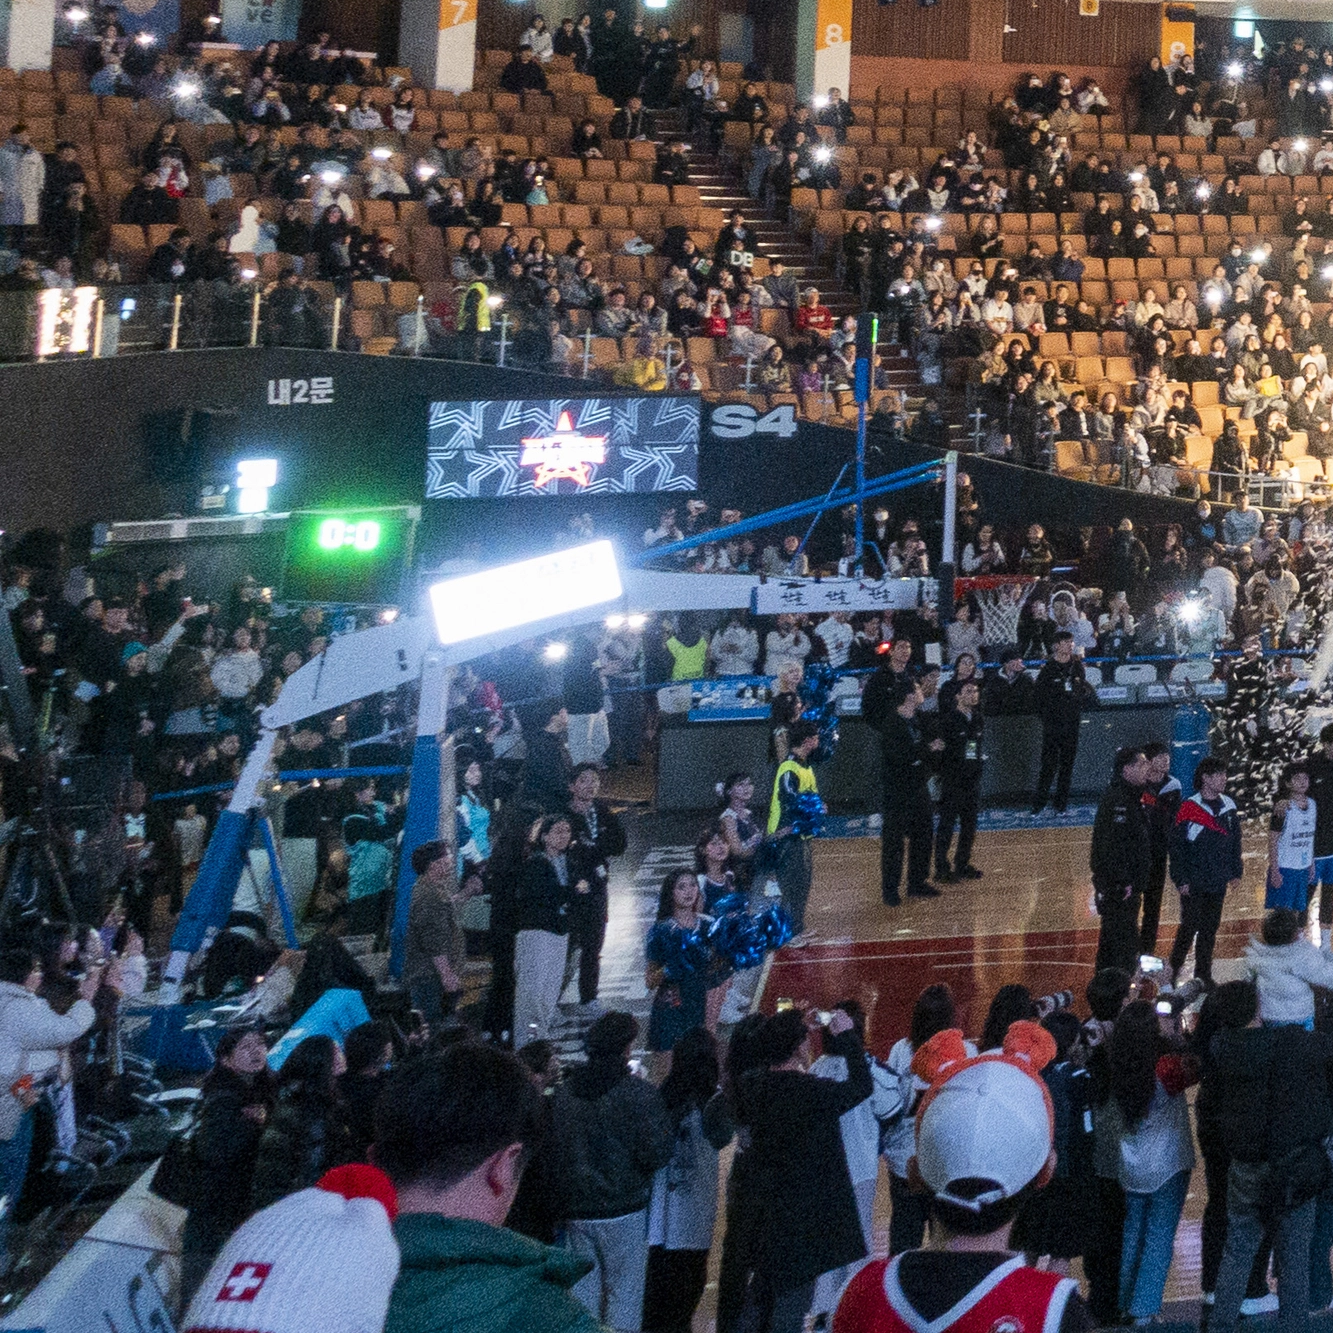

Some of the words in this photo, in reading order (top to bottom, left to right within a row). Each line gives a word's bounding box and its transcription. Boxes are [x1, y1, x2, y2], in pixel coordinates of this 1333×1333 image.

[450, 0, 469, 25] 7
[825, 23, 843, 47] 8
[267, 376, 334, 406] 내2문
[711, 403, 798, 439] S4
